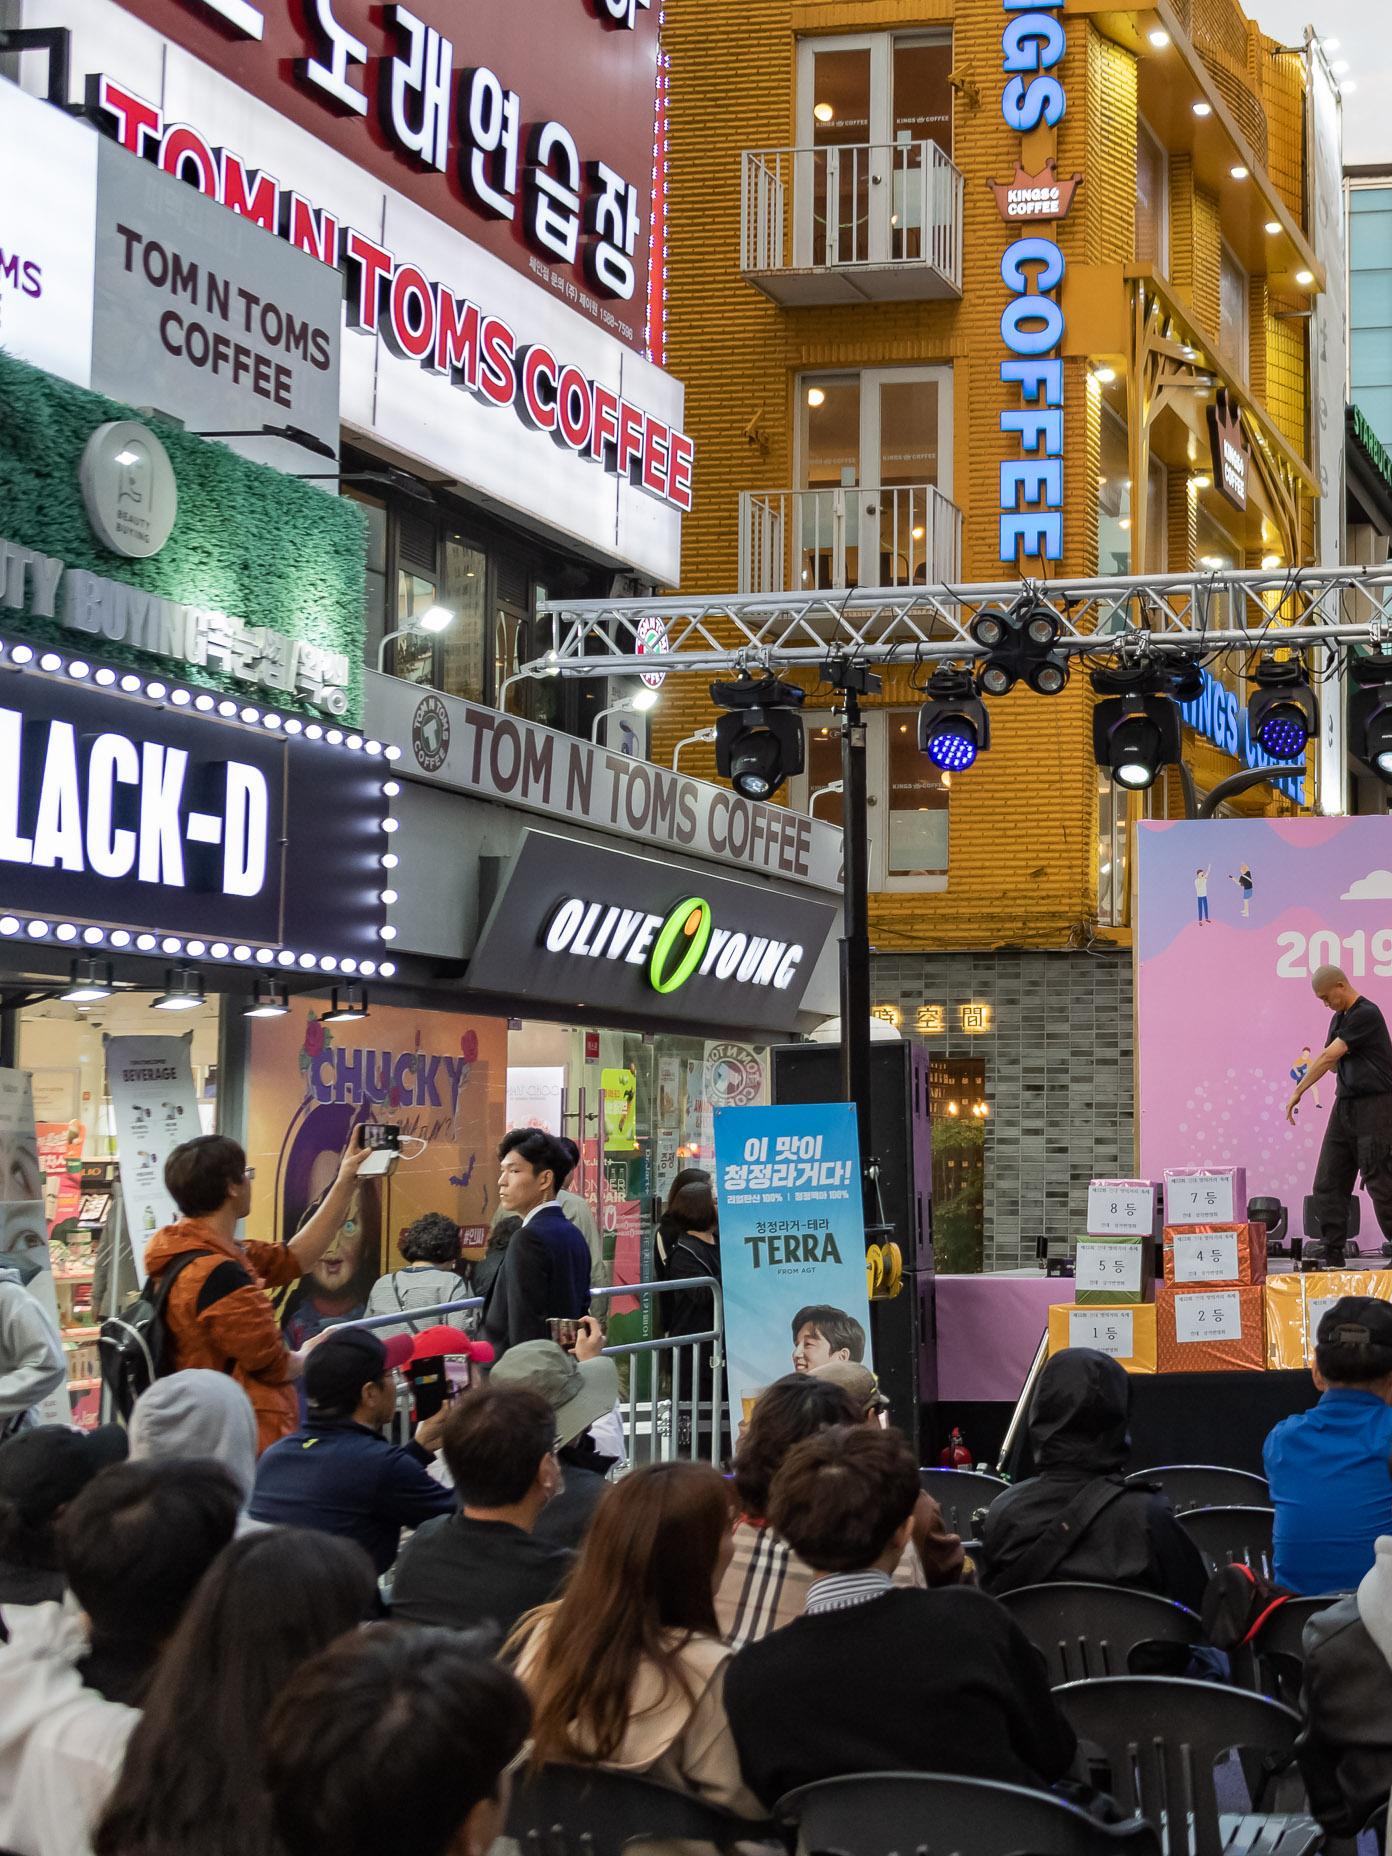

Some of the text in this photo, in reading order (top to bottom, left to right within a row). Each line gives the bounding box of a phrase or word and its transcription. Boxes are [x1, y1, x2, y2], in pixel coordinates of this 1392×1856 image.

[1001, 0, 1066, 131] GS
[896, 115, 949, 124] KINGS COFFEE
[1007, 201, 1060, 215] COFFEE
[100, 73, 694, 515] TOM N TOMS COFFEE
[116, 223, 331, 372] TOM N TOMS
[159, 310, 293, 410] COFFEE
[1000, 237, 1065, 563] COFFEE
[912, 453, 936, 461] COFFEE
[1224, 462, 1245, 500] COFFEE
[64, 568, 207, 666] BUYING
[414, 698, 449, 740] TOM N TOMS
[414, 740, 446, 769] COFFEE
[465, 708, 554, 804] TOM
[566, 743, 594, 815] N
[605, 756, 699, 845] TOMS
[707, 792, 812, 877] COFFEE
[546, 898, 803, 989] OLIVE YOUNG
[123, 1067, 178, 1083] BEVERAGE
[311, 1047, 466, 1116] CHUCKY
[744, 1135, 823, 1162] 이 맛이
[724, 1160, 852, 1190] 청정라거다!
[762, 1192, 783, 1202] 100%
[829, 1190, 849, 1200] 100%
[1110, 1203, 1137, 1217] 8 등
[1190, 1191, 1217, 1205] 7 등
[756, 1218, 829, 1234] 청정라거-테라
[744, 1232, 843, 1269] TERRA
[1196, 1249, 1222, 1263] 4 등
[1098, 1260, 1125, 1274] 5 등
[1198, 1309, 1225, 1323] 2 등
[1092, 1327, 1117, 1340] 1 등
